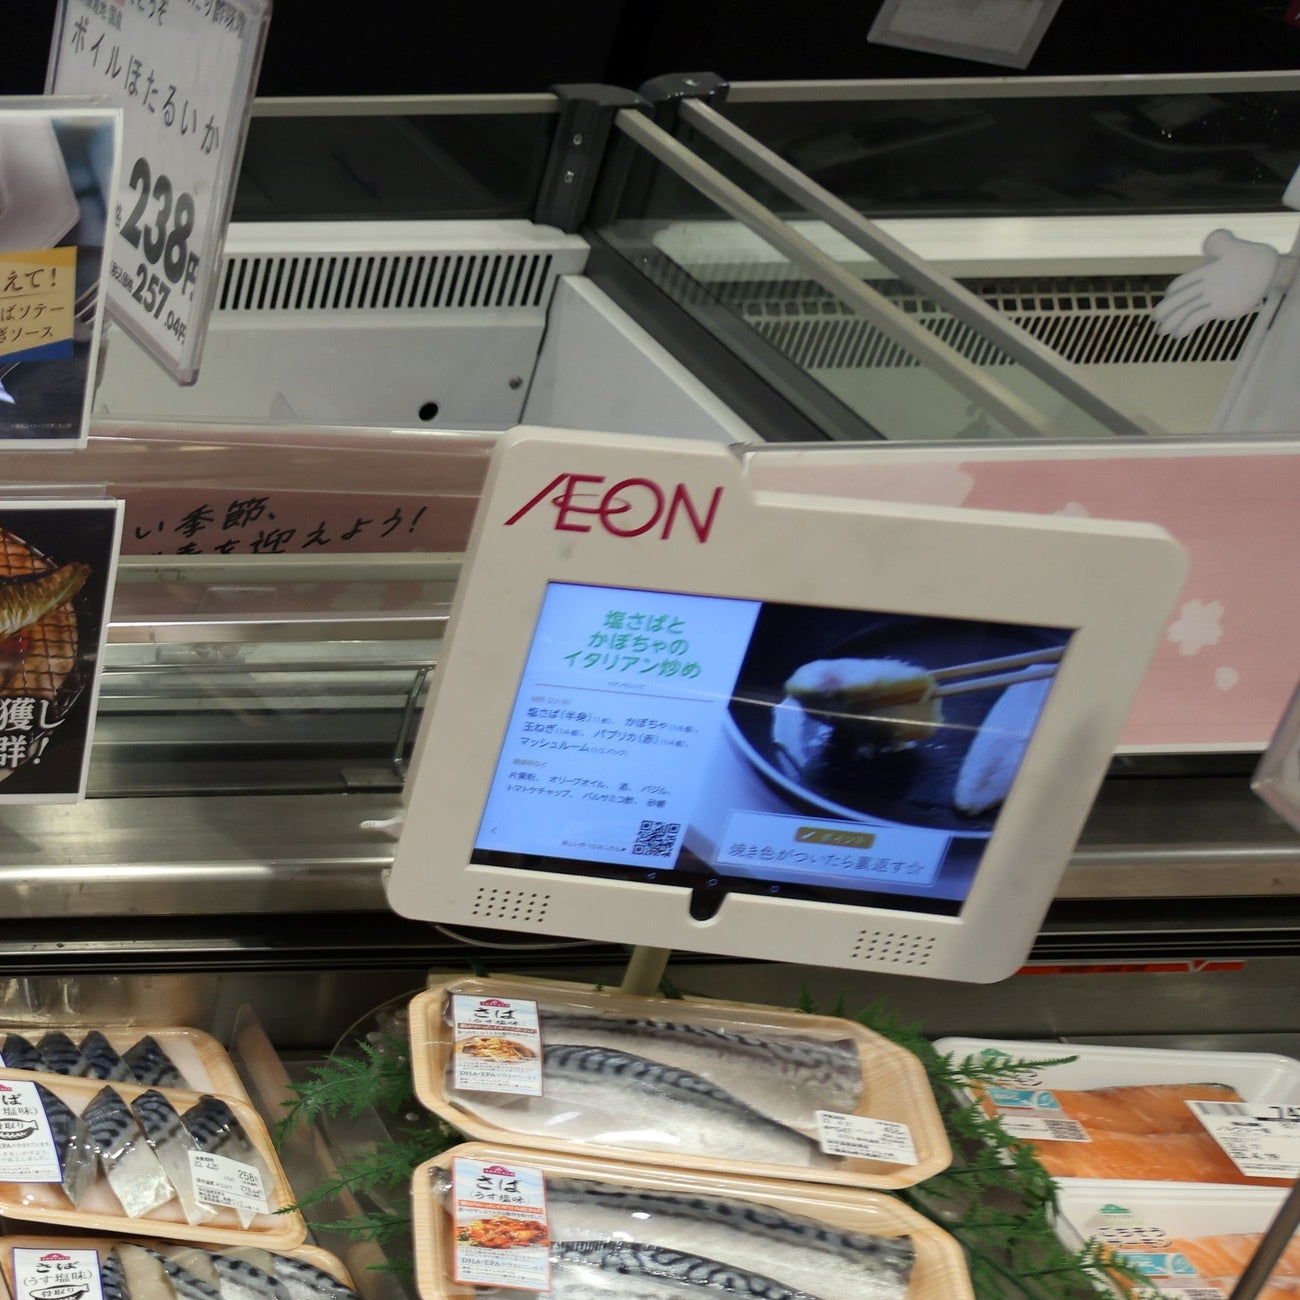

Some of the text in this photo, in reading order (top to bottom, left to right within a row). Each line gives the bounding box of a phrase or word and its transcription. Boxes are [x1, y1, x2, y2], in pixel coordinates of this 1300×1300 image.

[70, 16, 220, 154] ボイルほたるいか
[603, 610, 686, 634] 塩さばと
[588, 631, 690, 656] かぼちゃの
[564, 652, 702, 679] イタリアン炒め
[473, 1007, 514, 1020] さば
[476, 1175, 520, 1194] さば
[36, 1261, 79, 1273] さば
[22, 1270, 93, 1287] (うす塩味)
